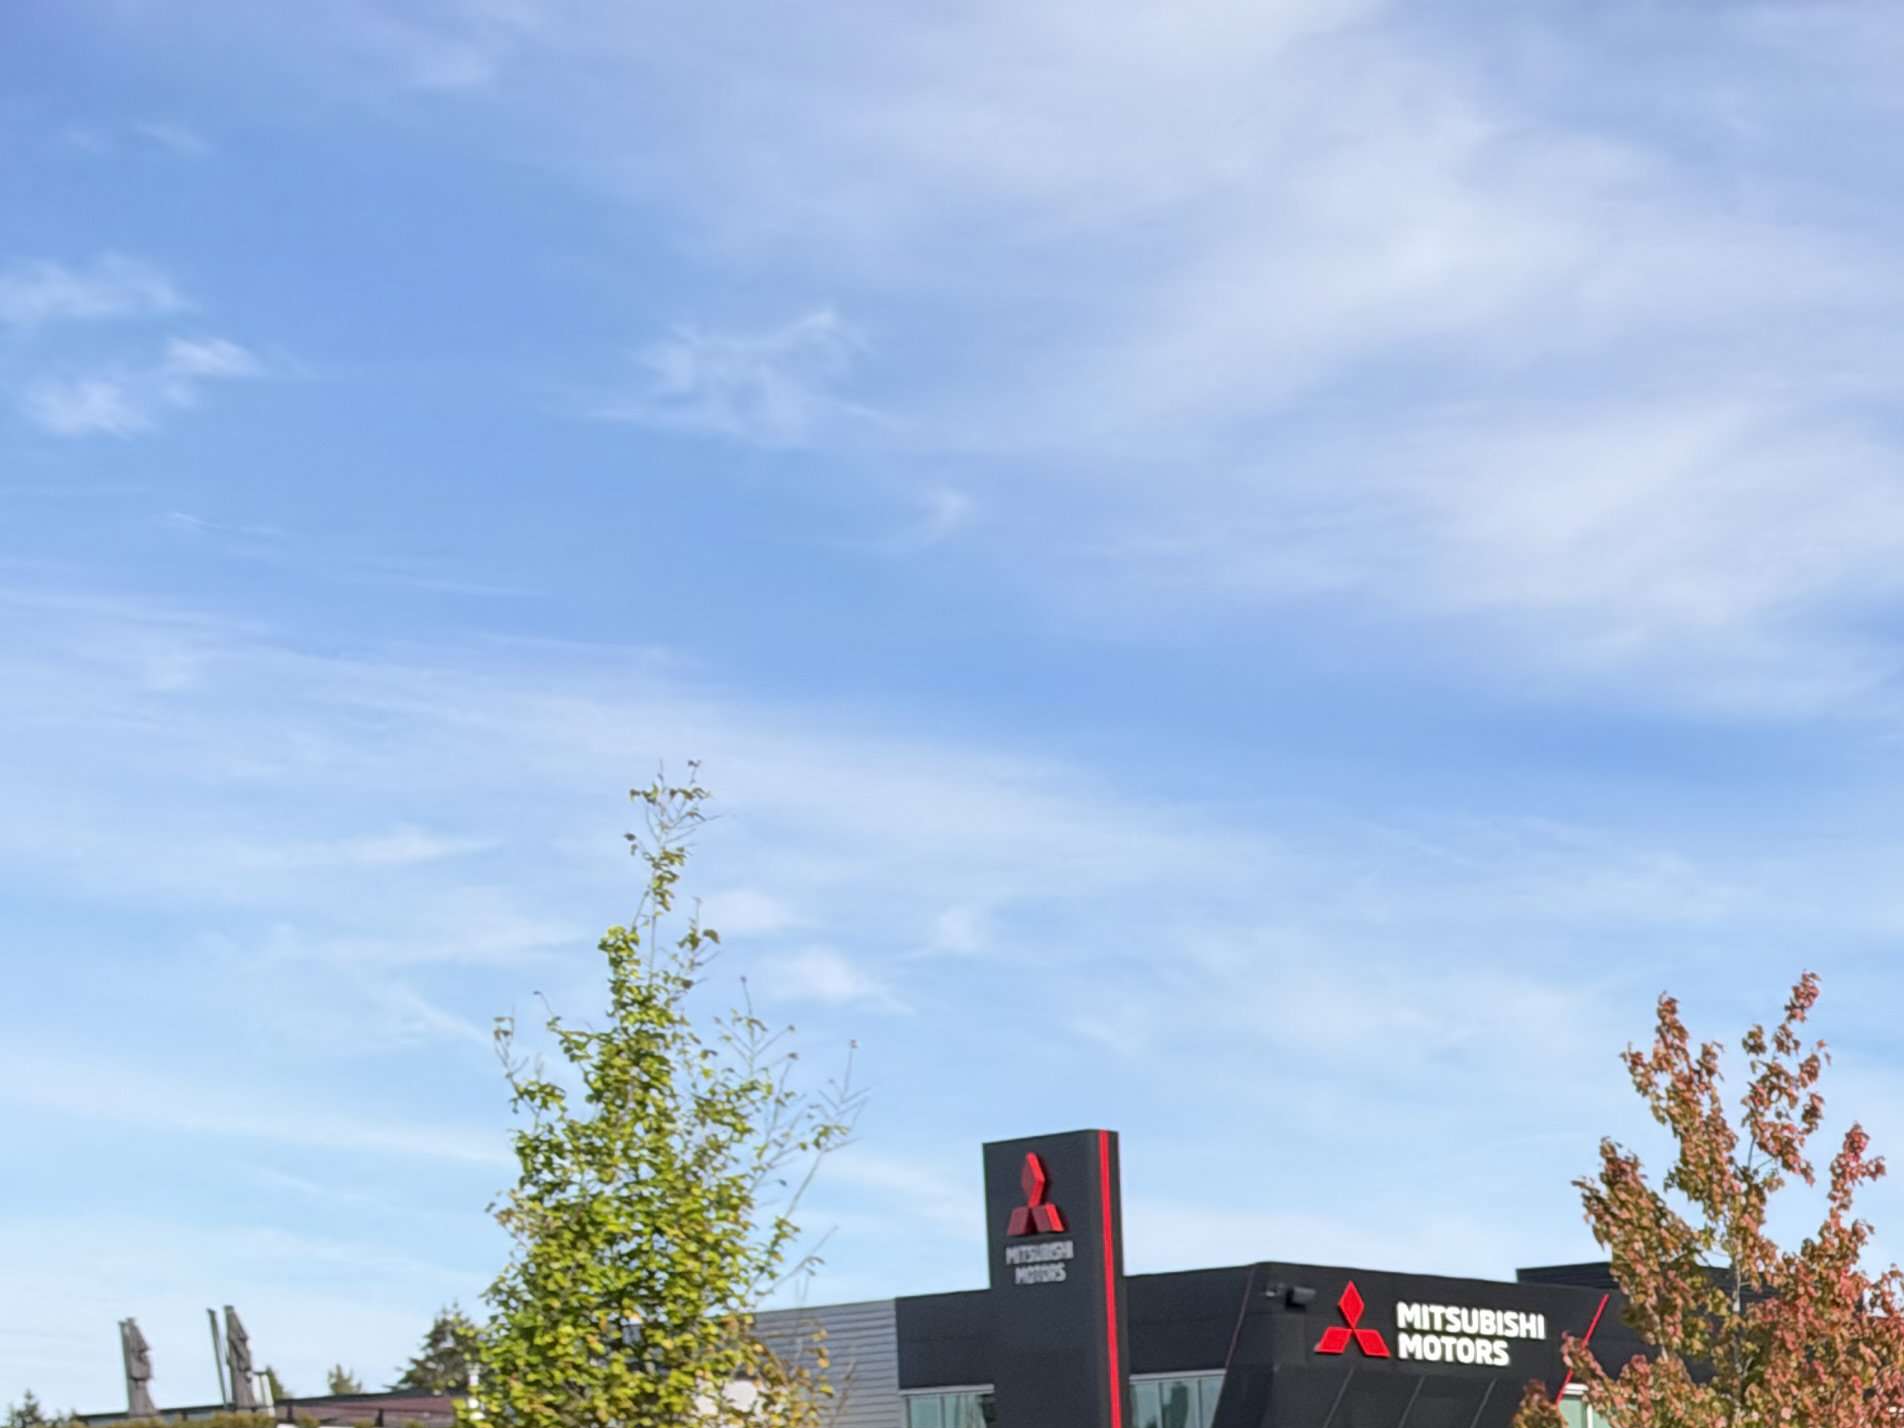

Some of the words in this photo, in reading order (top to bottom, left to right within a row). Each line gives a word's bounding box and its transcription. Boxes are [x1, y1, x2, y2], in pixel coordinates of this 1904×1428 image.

[1005, 1240, 1074, 1265] MITSUBISHI
[1015, 1261, 1067, 1285] MOTORS
[1396, 1301, 1547, 1340] MITSUBISHI
[1398, 1331, 1510, 1367] MOTORS
